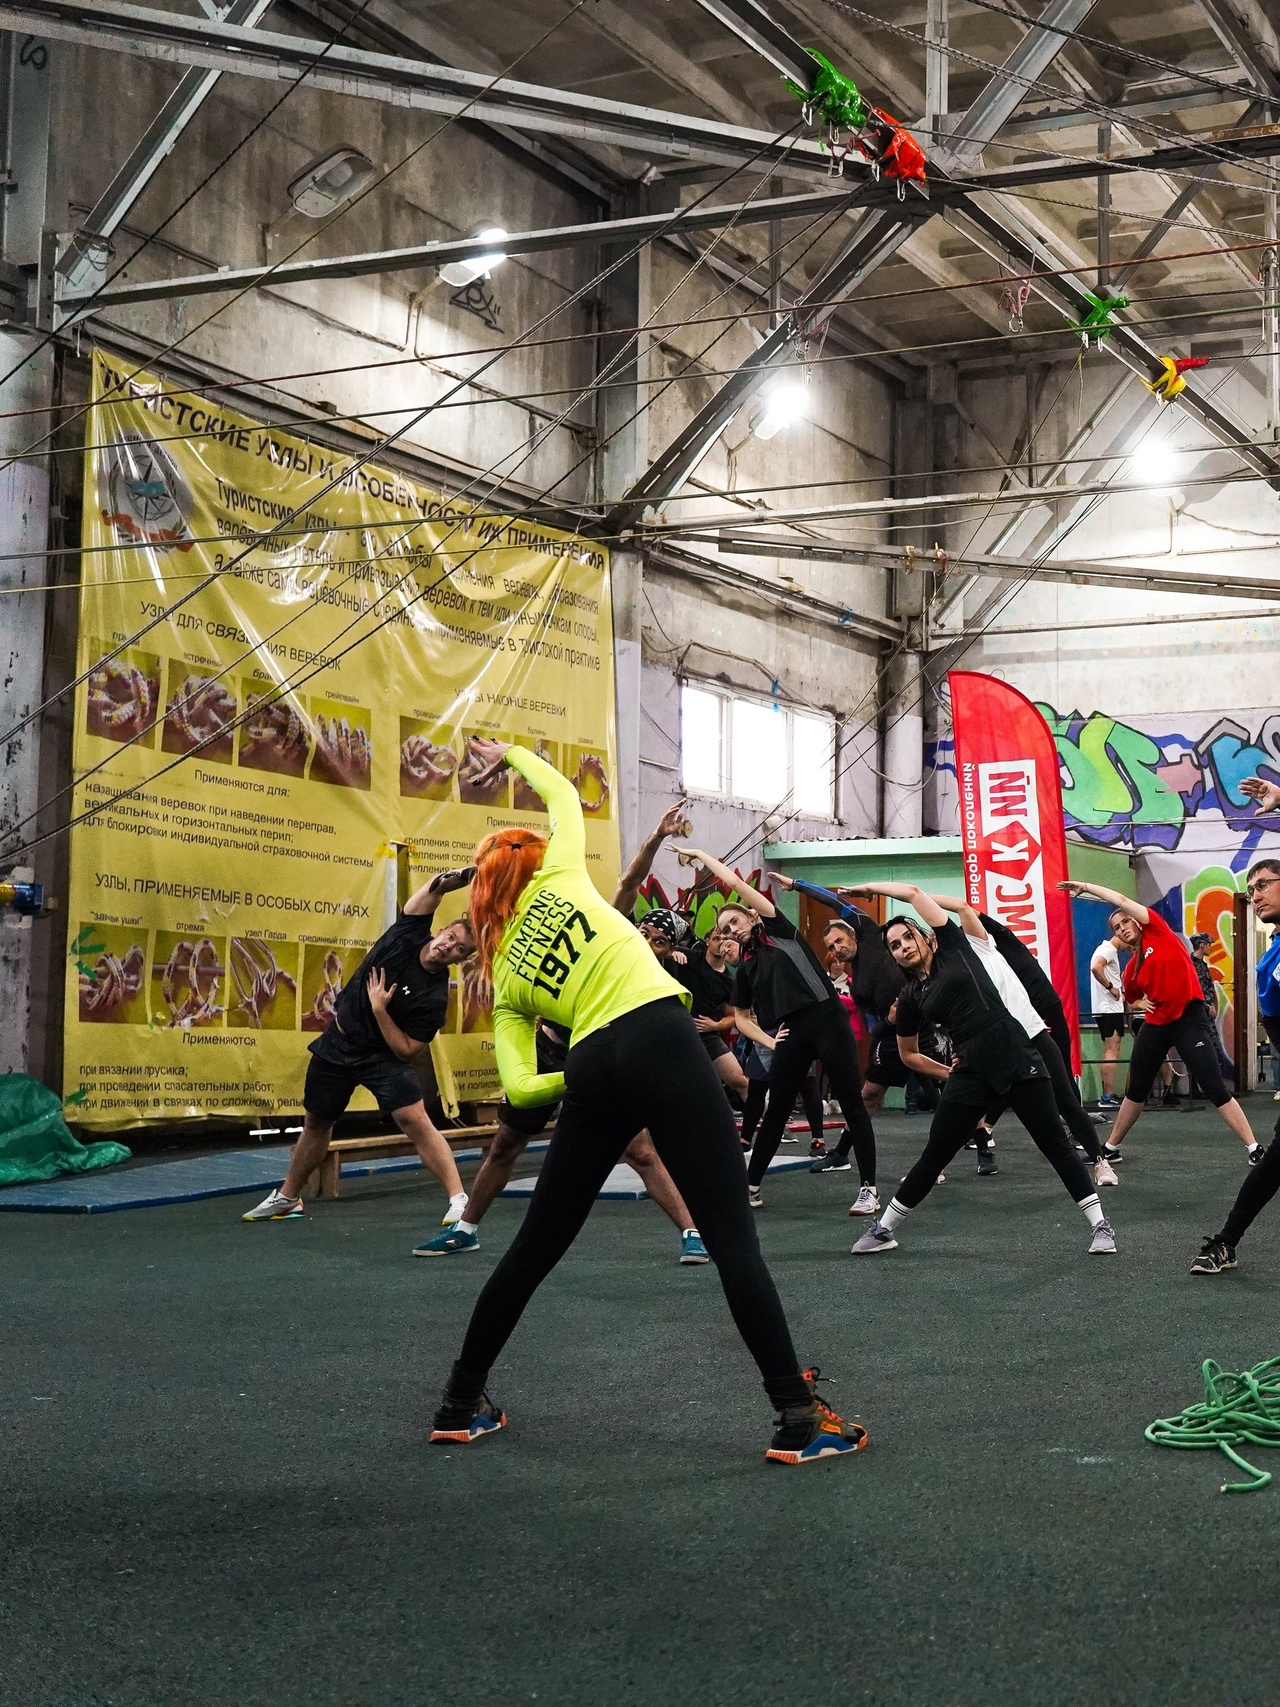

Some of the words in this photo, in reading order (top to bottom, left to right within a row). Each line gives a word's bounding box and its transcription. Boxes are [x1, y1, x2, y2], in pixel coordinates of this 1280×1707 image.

[215, 476, 296, 523] Туристские
[320, 459, 334, 481] И
[477, 521, 502, 544] ИХ
[422, 582, 467, 611] верёвок
[478, 601, 493, 618] тем
[177, 612, 203, 633] ДЛЯ
[289, 650, 342, 672] ВЕРЕВОК
[508, 638, 517, 652] в
[564, 647, 601, 671] практике
[529, 699, 566, 718] ВЕРЕВКИ
[194, 769, 265, 794] Применяются
[160, 797, 207, 814] веревок
[208, 805, 228, 817] при
[230, 809, 285, 826] наведении
[287, 818, 337, 836] переправ,
[162, 812, 169, 823] и
[171, 814, 258, 837] горизонтальных
[260, 828, 294, 844] перил;
[106, 816, 168, 839] блокировки
[170, 829, 260, 852] индивидуальной
[262, 843, 331, 862] страховочной
[332, 854, 374, 869] системы
[95, 872, 131, 893] УЗЛЫ,
[133, 878, 241, 905] ПРИМЕНЯЕМЫЕ
[244, 892, 253, 906] В
[256, 894, 311, 912] ОСОБЫХ
[263, 929, 287, 941] Гарда
[507, 889, 556, 973] JUMPING
[516, 897, 575, 984] FITNESS
[533, 910, 598, 1001] 1977
[79, 1064, 97, 1077] при
[99, 1064, 143, 1076] вязании
[99, 1081, 162, 1094] проведении
[164, 1081, 241, 1093] спасательных
[243, 1080, 275, 1095] работ;
[100, 1098, 149, 1110] движении
[152, 1098, 160, 1108] в
[205, 1098, 219, 1108] по
[221, 1096, 275, 1111] сложному
